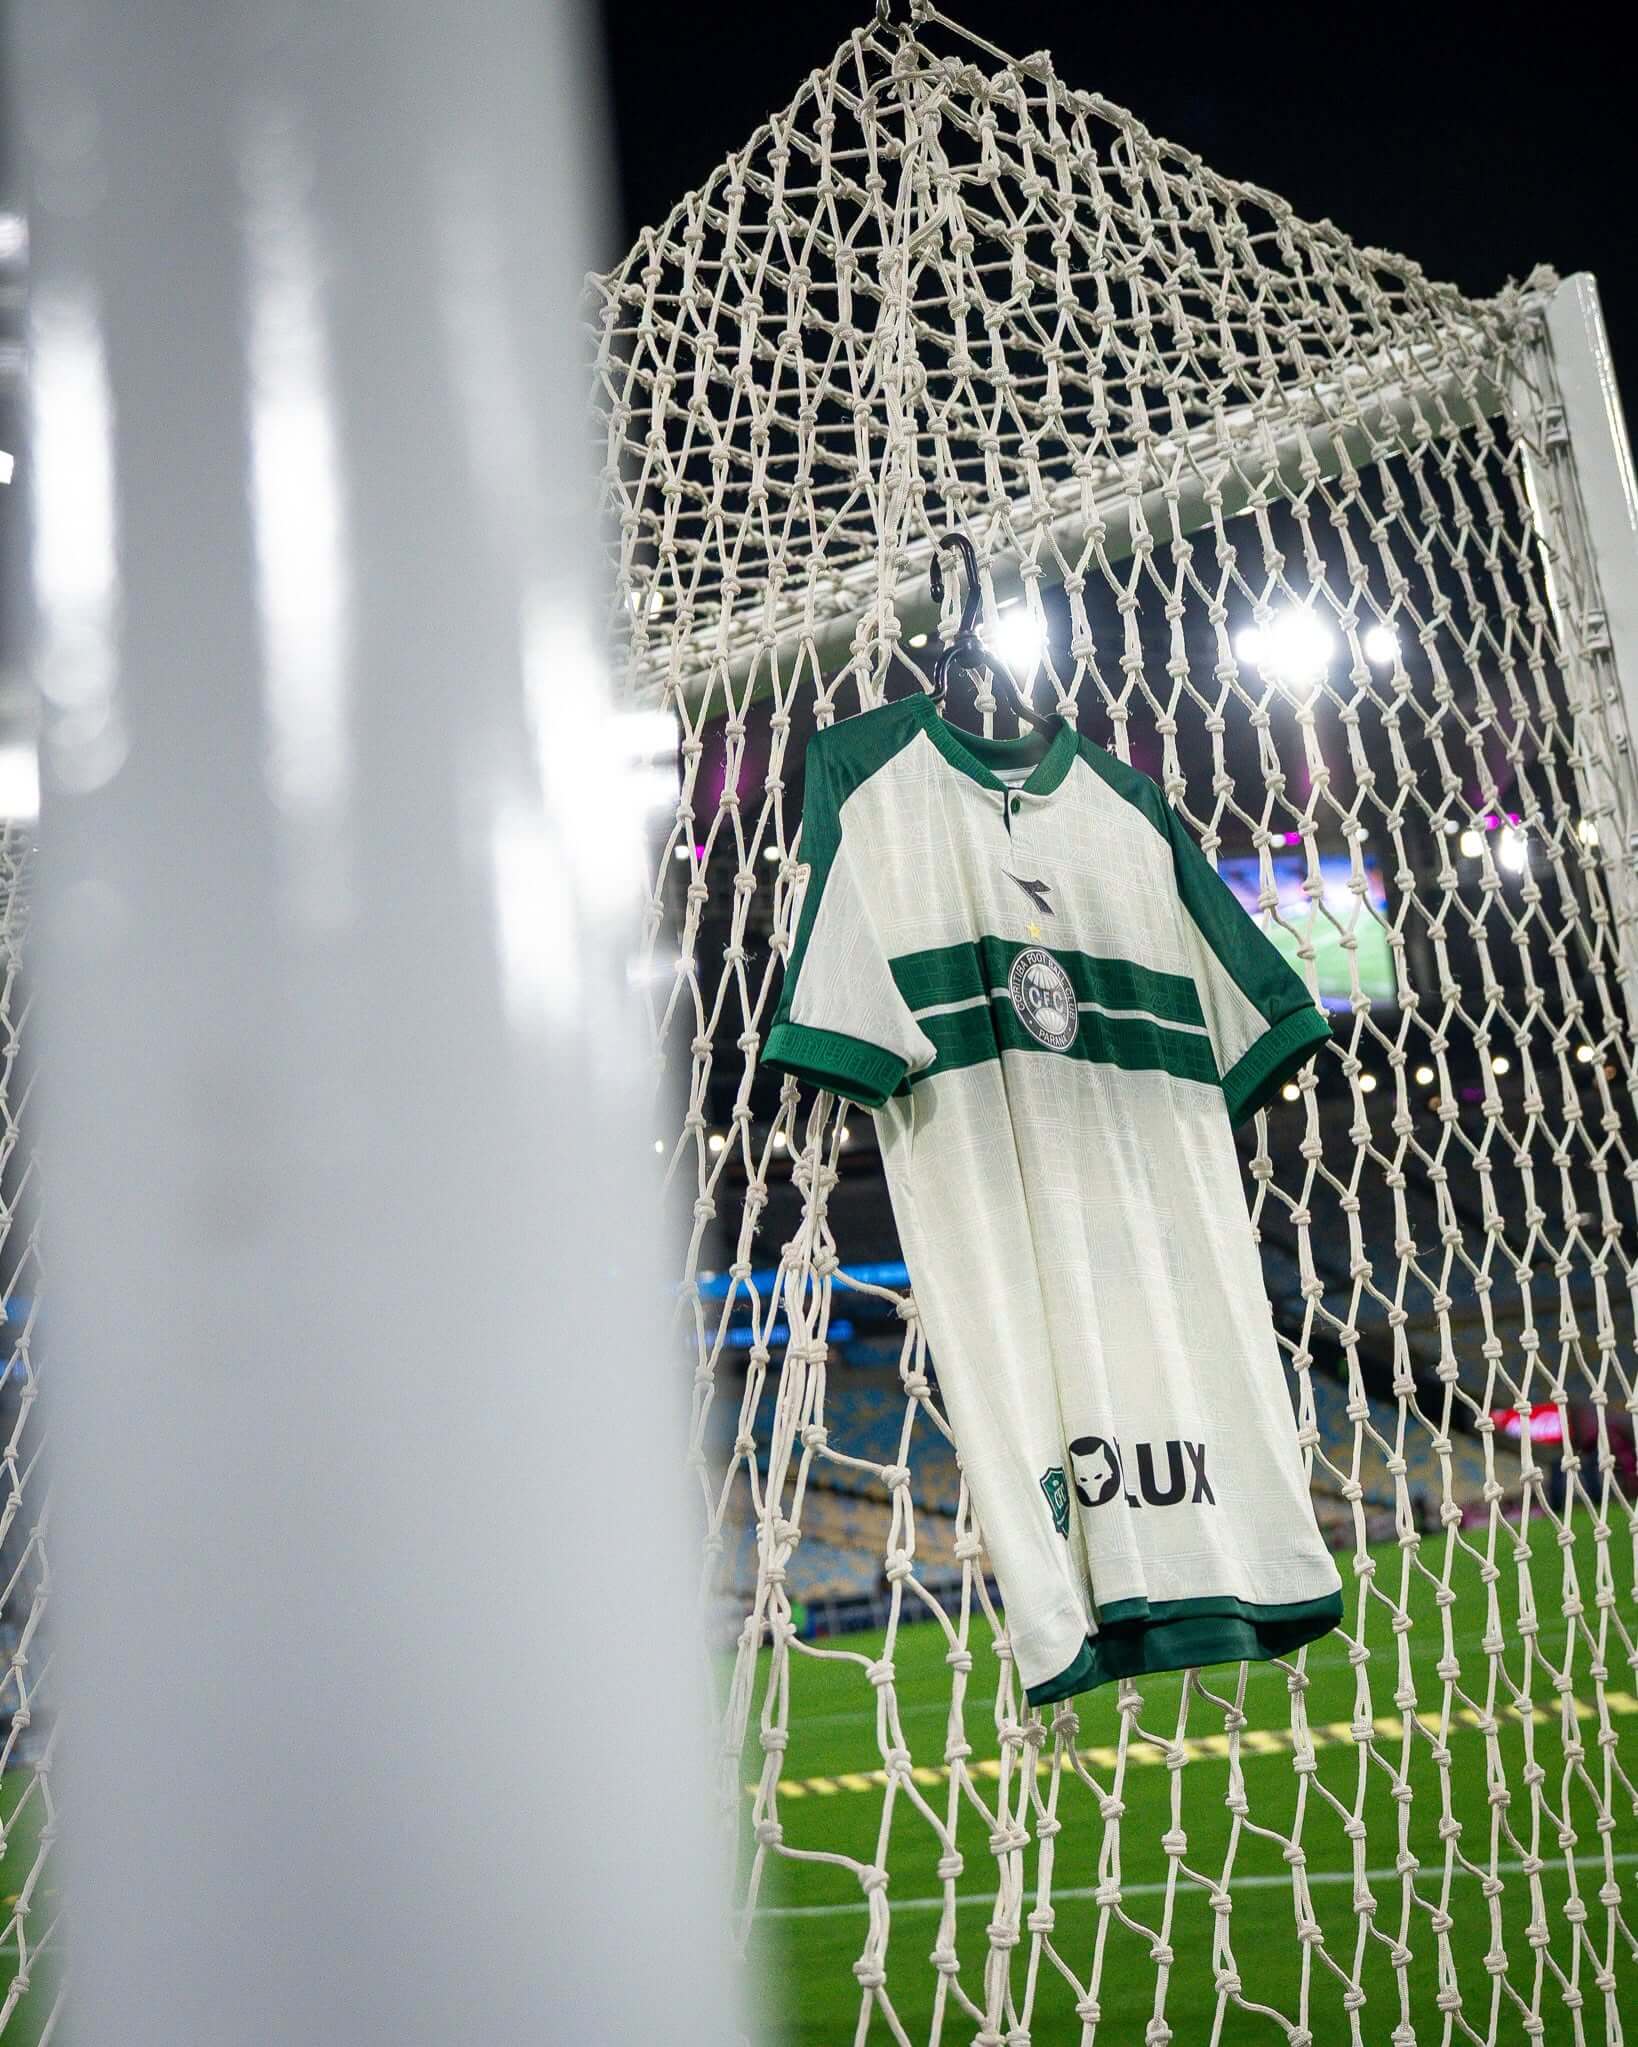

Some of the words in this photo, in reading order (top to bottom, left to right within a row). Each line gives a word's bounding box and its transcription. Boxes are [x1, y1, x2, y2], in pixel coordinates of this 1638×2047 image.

[1012, 962, 1028, 1011] CORITIBA
[1026, 952, 1046, 964] FOOT
[1048, 959, 1066, 983] BALL
[1065, 987, 1076, 1020] CLUB
[1029, 986, 1064, 1013] CFC
